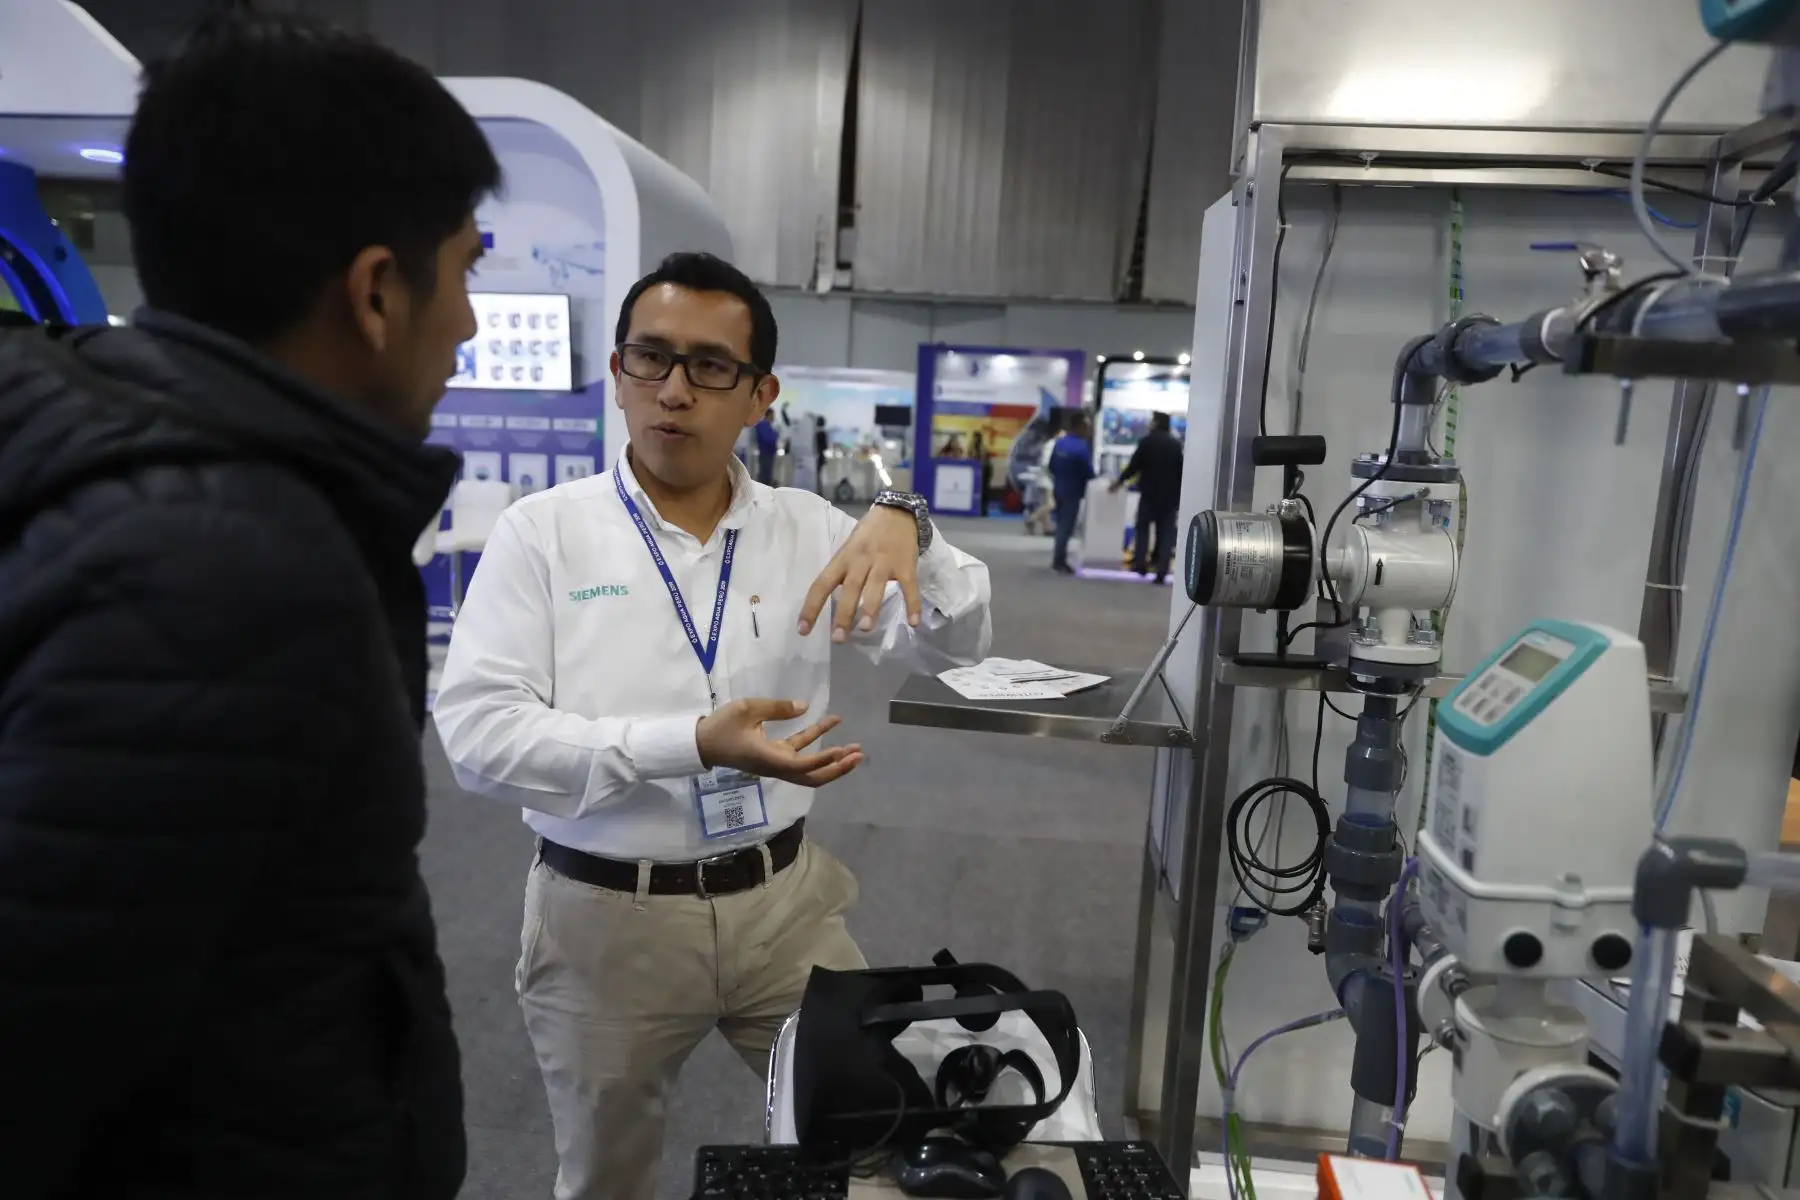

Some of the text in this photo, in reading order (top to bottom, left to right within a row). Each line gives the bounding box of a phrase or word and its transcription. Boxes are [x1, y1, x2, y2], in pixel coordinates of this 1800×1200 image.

[568, 583, 629, 602] SIEMENS
[680, 607, 689, 623] AGUA
[685, 622, 697, 638] EXPO
[711, 621, 720, 636] EXPO
